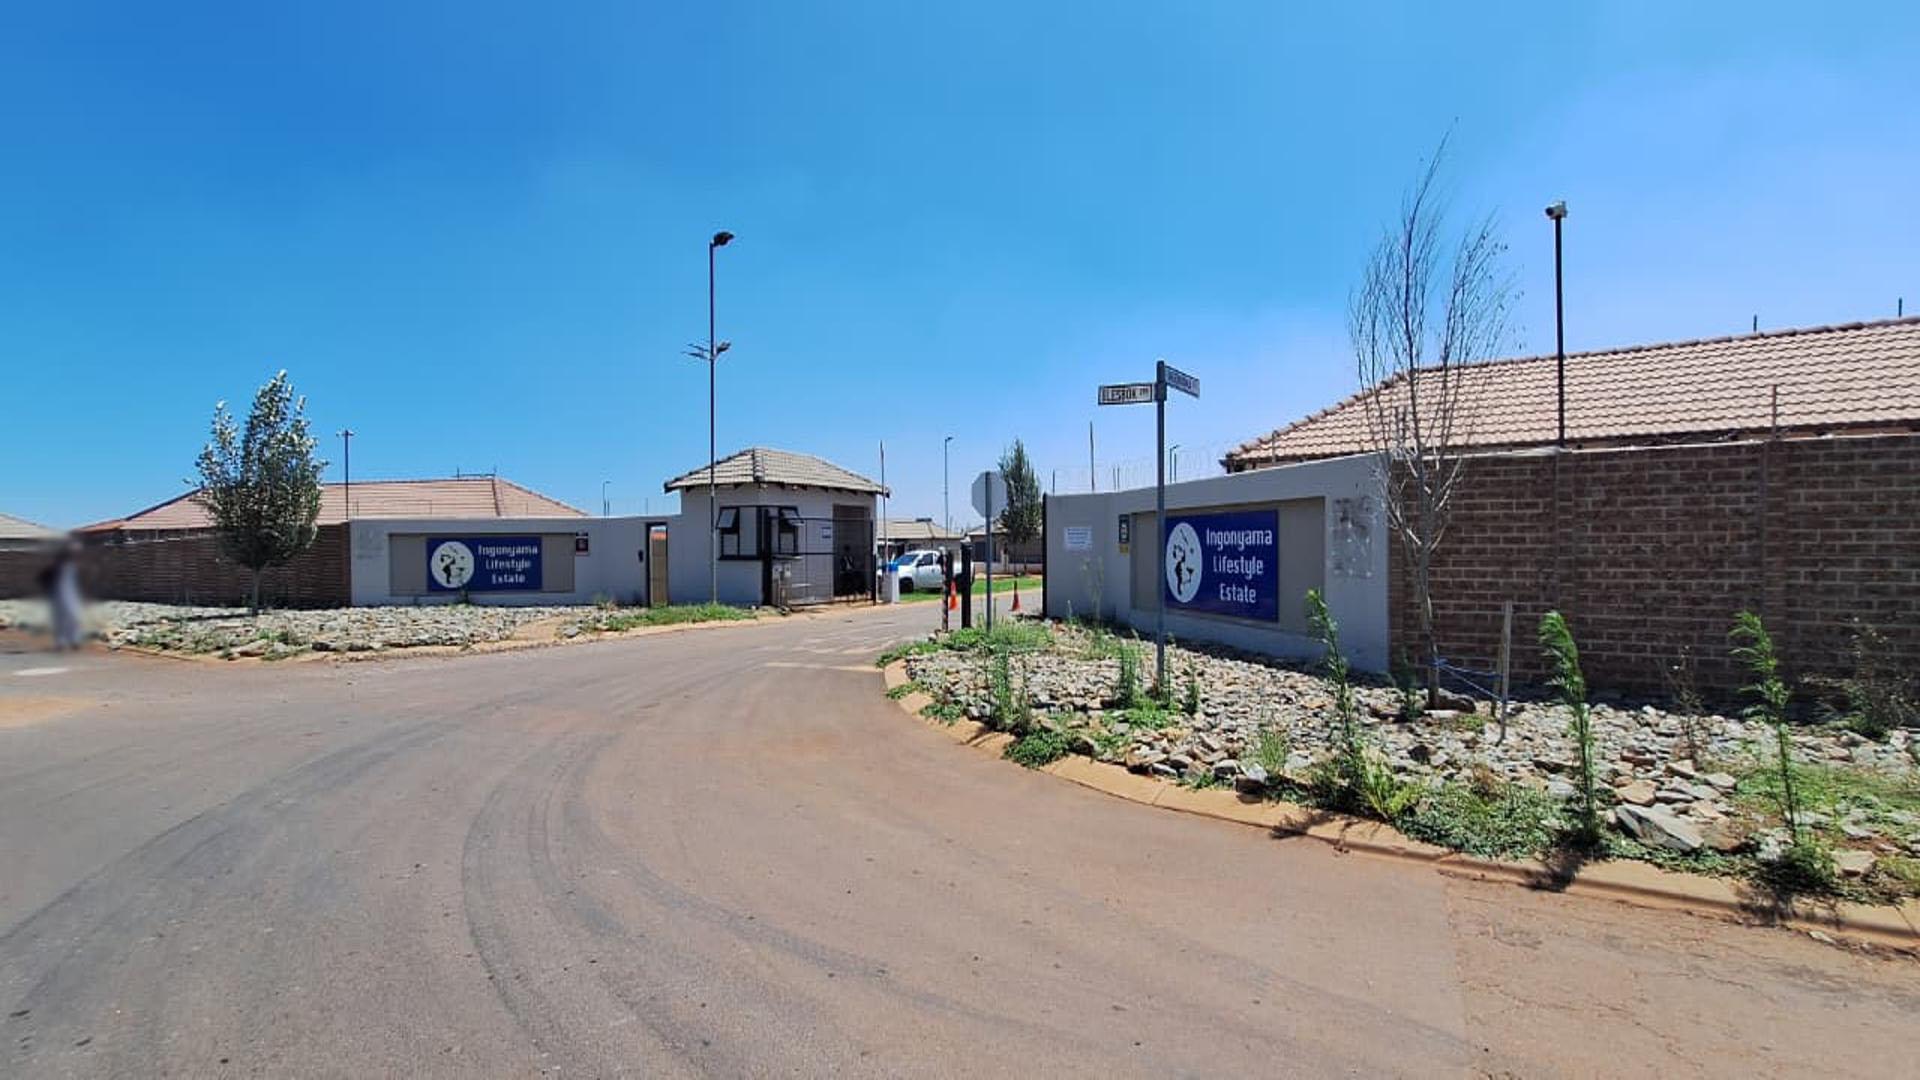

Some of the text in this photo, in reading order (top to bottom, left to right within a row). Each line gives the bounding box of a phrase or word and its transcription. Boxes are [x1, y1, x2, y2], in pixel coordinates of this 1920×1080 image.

[1206, 528, 1272, 551] Ingonyama
[478, 545, 538, 557] Ingonyama
[486, 558, 531, 571] Lifestyle
[1213, 555, 1263, 580] Lifestyle
[492, 573, 525, 584] Estate
[1219, 583, 1257, 604] Estate
